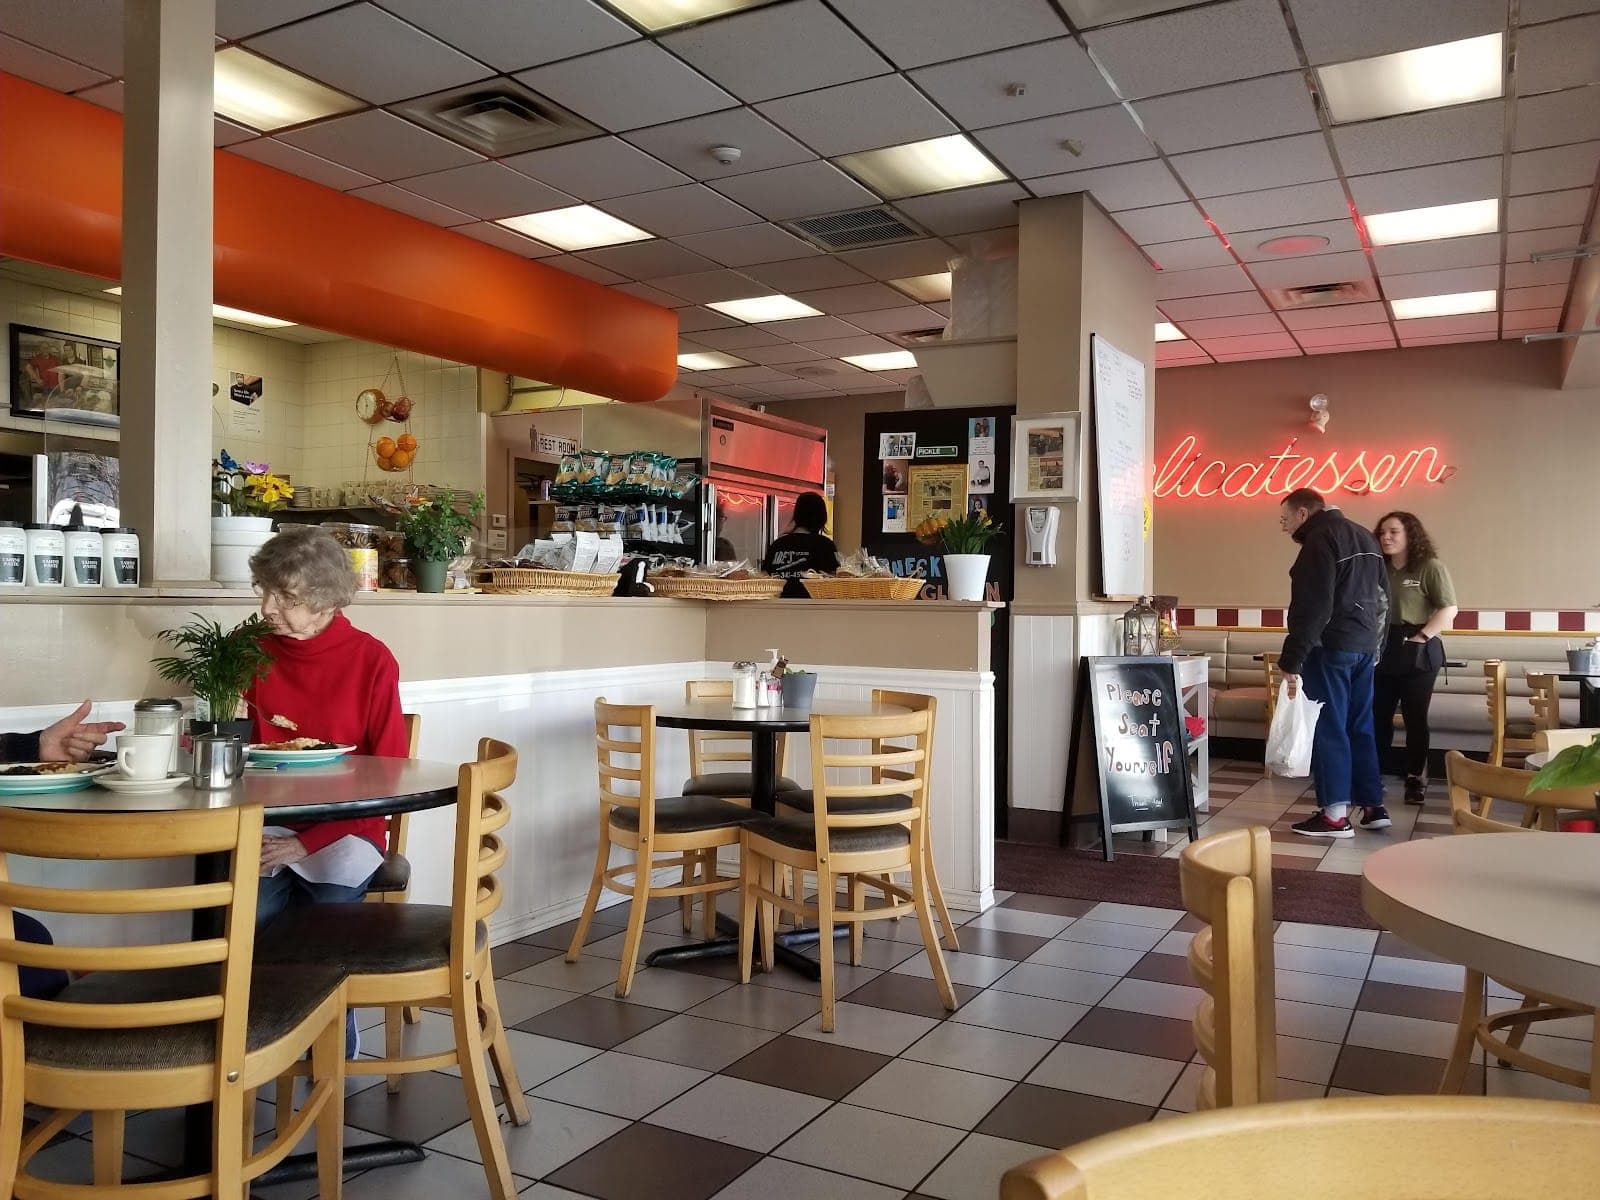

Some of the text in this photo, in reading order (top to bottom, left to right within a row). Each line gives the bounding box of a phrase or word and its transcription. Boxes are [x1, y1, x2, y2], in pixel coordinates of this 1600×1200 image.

[540, 437, 576, 454] REST ROOM
[918, 448, 941, 456] PICKLE
[1153, 435, 1448, 498] licatessen
[1106, 683, 1162, 707] Please
[1118, 712, 1161, 737] Seat
[1105, 740, 1174, 777] Yourself
